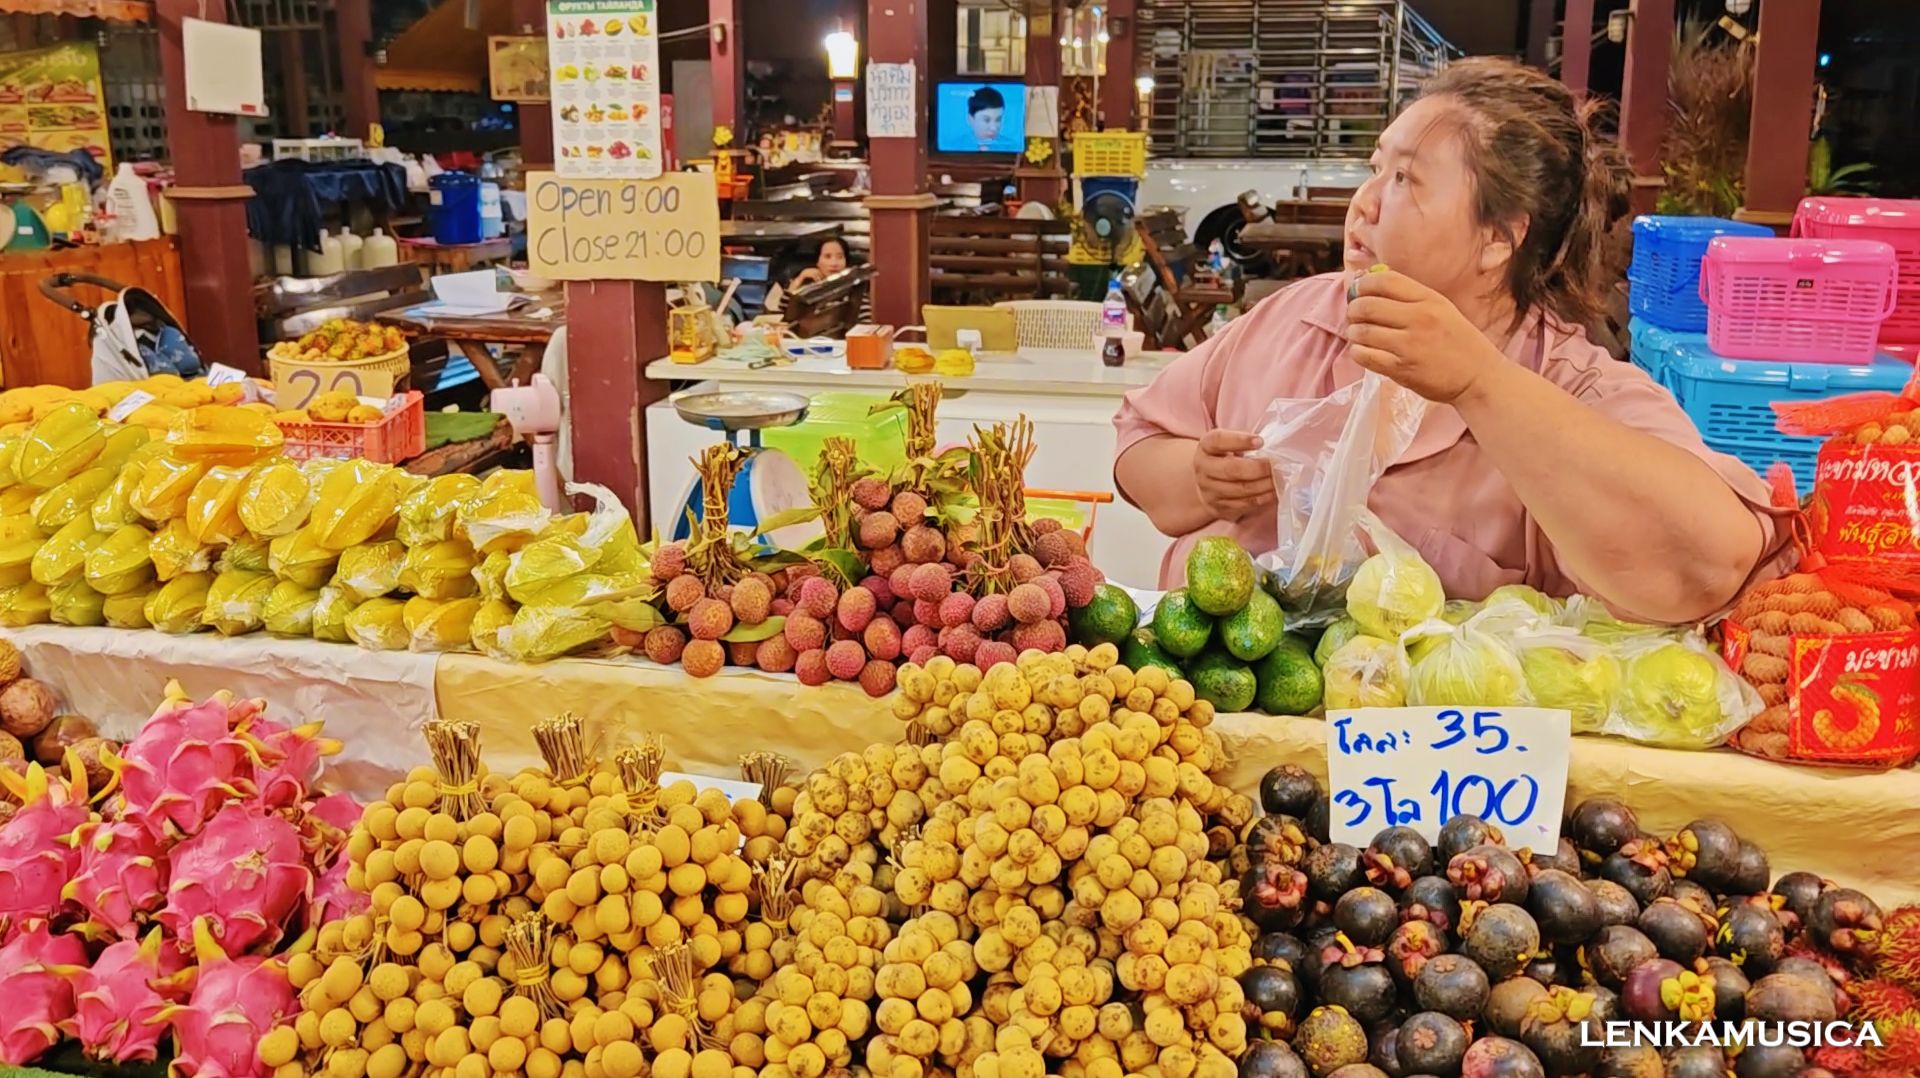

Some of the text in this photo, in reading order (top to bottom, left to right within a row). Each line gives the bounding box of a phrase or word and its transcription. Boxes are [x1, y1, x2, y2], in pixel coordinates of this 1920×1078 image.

[536, 181, 680, 222] Open 9:00
[537, 226, 705, 265] Close 21:00
[1430, 770, 1539, 826] 100
